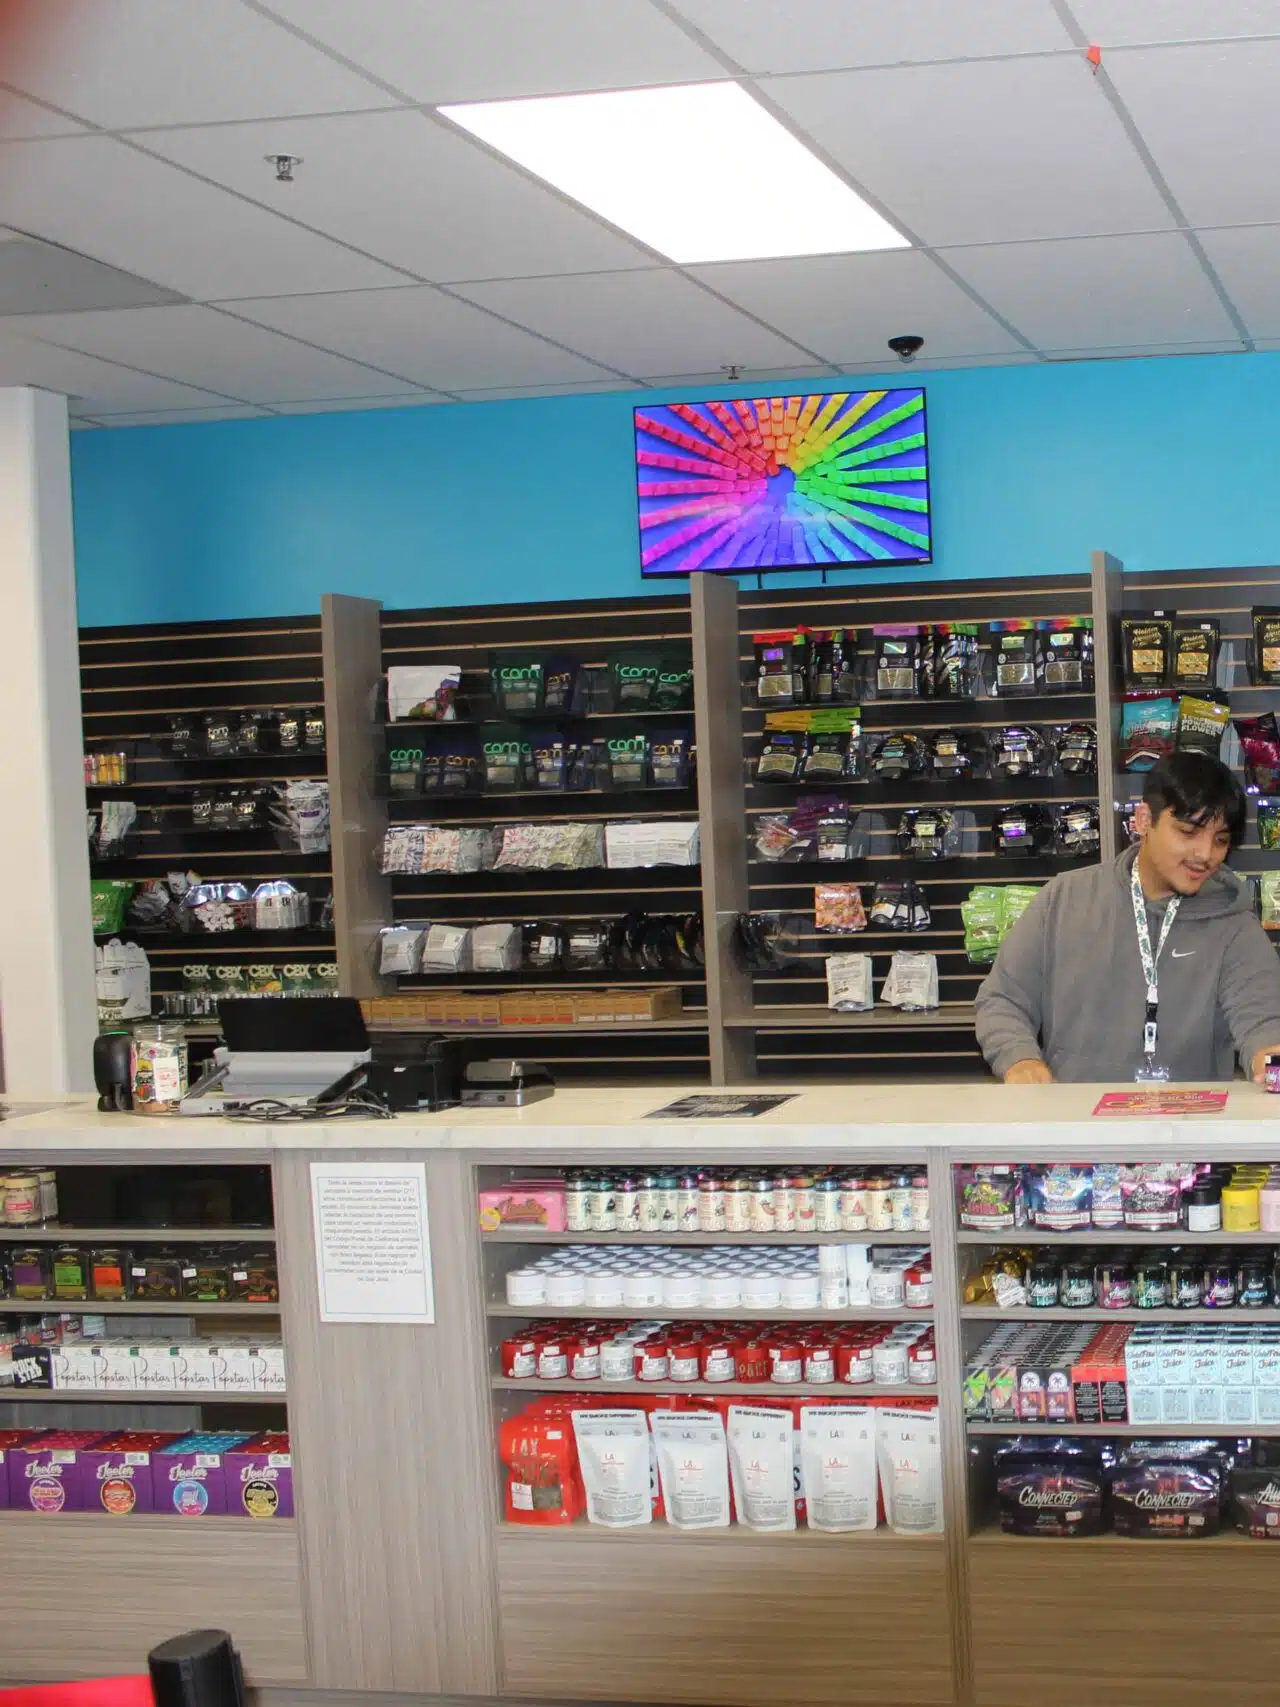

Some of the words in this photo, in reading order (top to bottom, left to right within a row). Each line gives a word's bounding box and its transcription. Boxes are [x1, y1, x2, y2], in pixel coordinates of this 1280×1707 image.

[316, 963, 339, 977] CB
[54, 1354, 91, 1388] Popstar
[92, 1354, 131, 1389] Popstar
[133, 1354, 170, 1389] Popstar
[172, 1354, 210, 1389] Popstar
[212, 1355, 250, 1389] Popstar
[250, 1355, 286, 1390] Popsta
[1018, 1486, 1079, 1509] CONNECTED
[1135, 1487, 1197, 1511] CONNECTED
